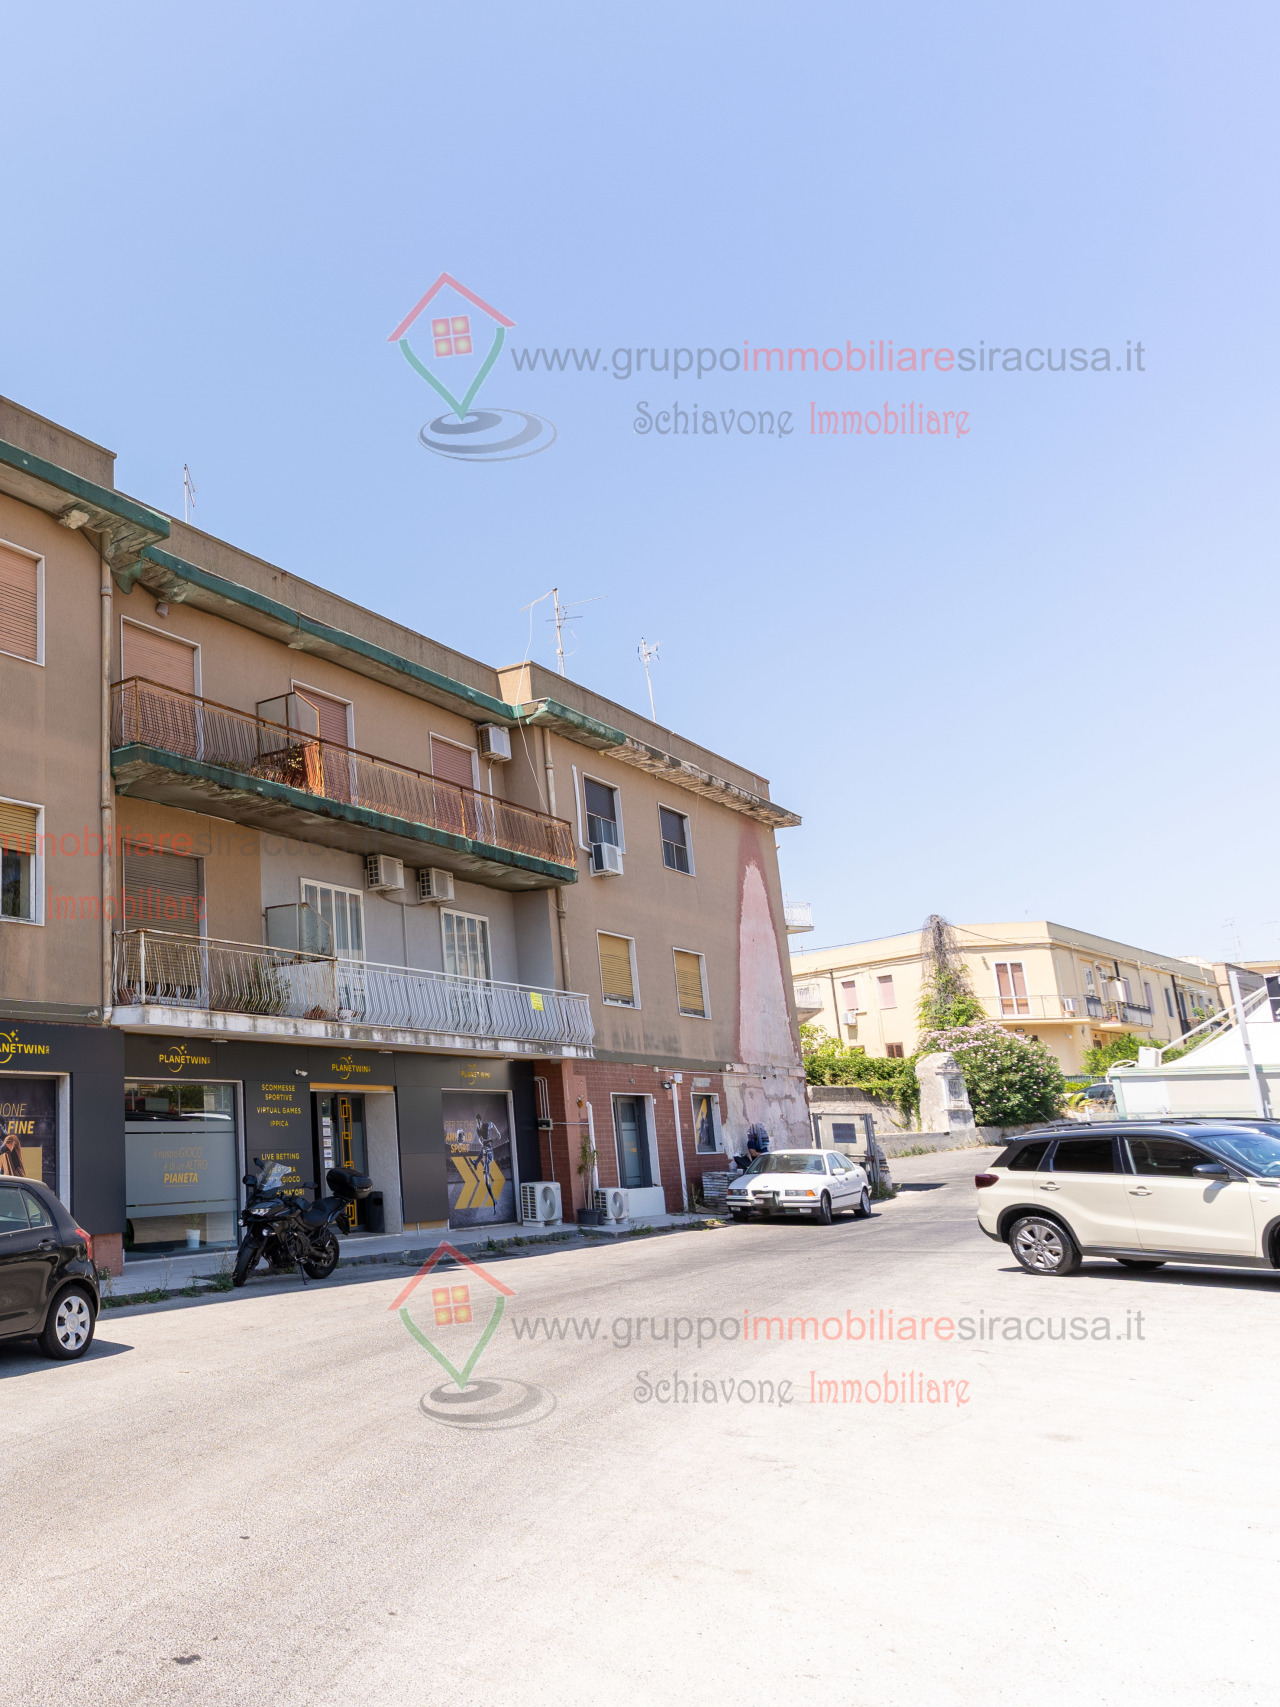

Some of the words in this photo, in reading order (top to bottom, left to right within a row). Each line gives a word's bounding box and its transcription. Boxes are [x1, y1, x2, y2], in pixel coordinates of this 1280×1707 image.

[158, 1054, 207, 1064] PLANETWIN
[331, 1064, 369, 1072] PLANETWIN
[261, 1083, 296, 1092] SCOMMESSE
[265, 1093, 292, 1101] SPORTIVE
[256, 1106, 281, 1114] VIRTUAL
[7, 1120, 35, 1135] FINE
[179, 1146, 203, 1158] GIOCO
[451, 1143, 470, 1153] SPORT
[163, 1172, 198, 1183] PIANETA
